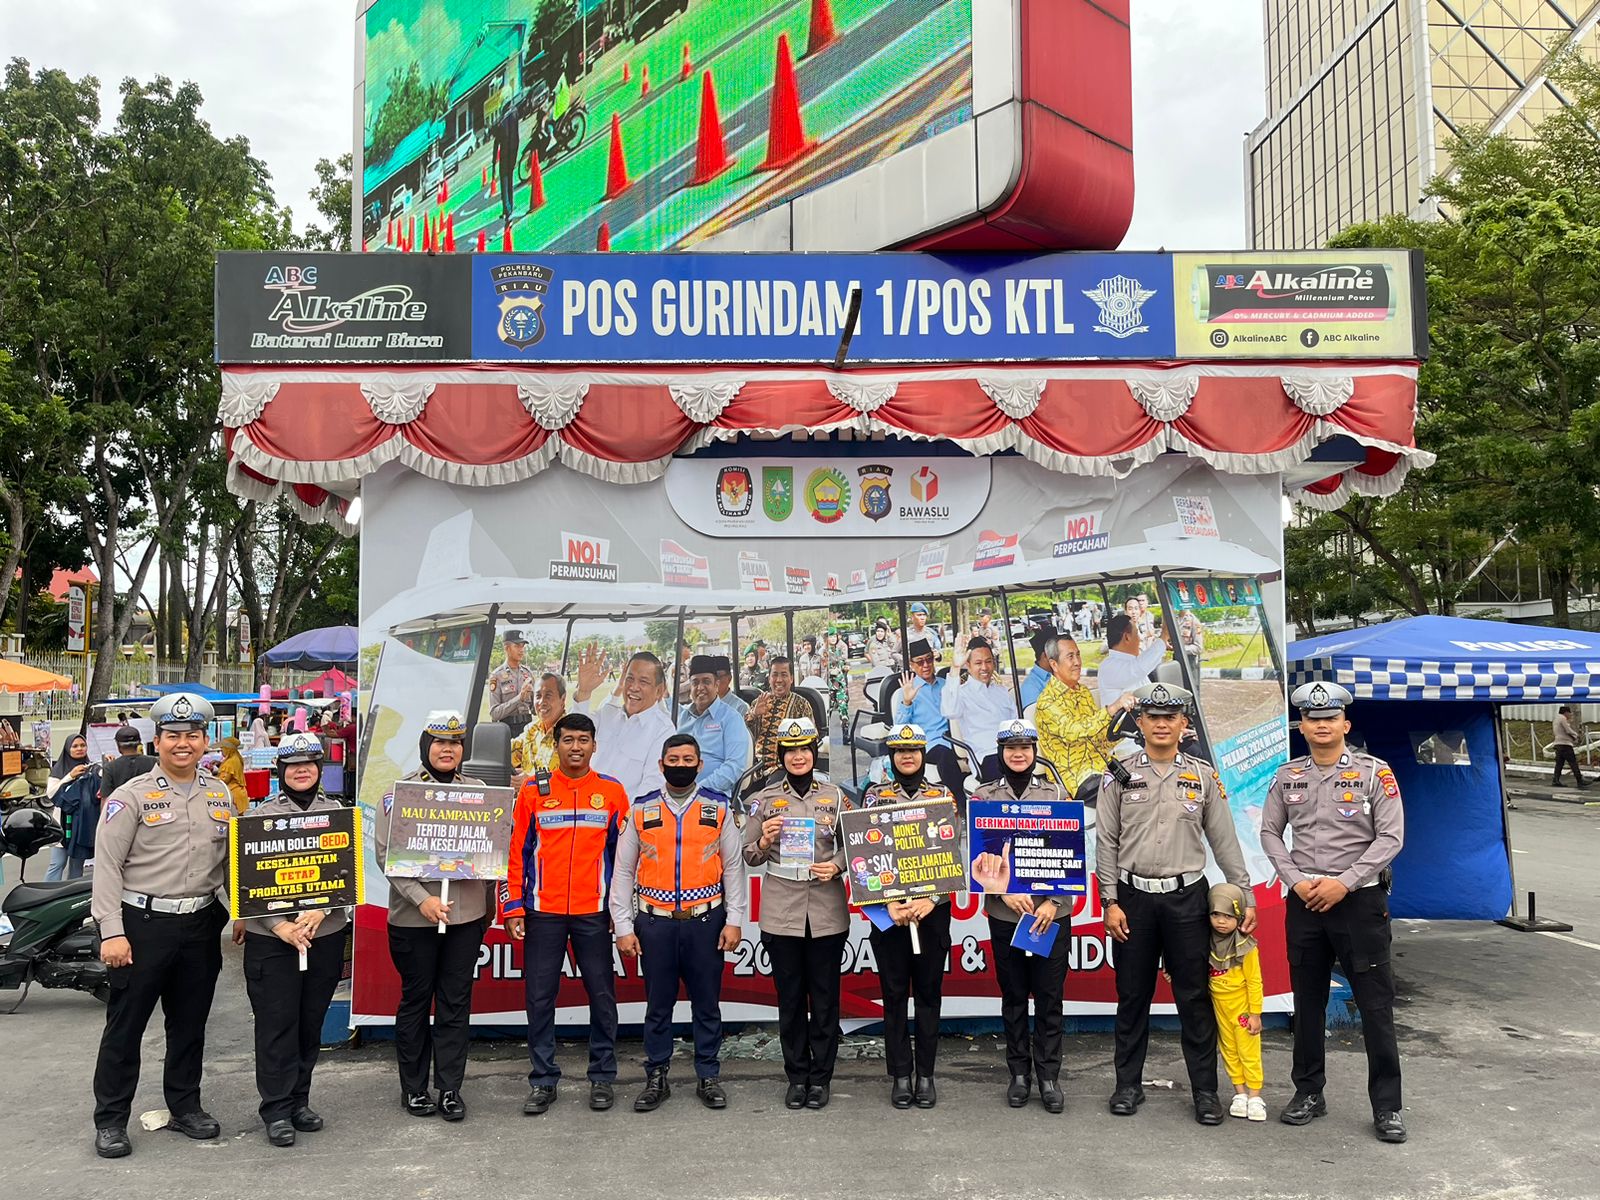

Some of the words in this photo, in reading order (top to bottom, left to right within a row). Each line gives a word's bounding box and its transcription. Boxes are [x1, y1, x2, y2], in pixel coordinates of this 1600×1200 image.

[265, 266, 317, 284] ABC
[1215, 275, 1245, 288] ABC
[1245, 270, 1373, 290] Alkaline
[500, 282, 542, 291] RIAU
[268, 291, 428, 321] Alkaline
[563, 279, 637, 336] POS
[652, 279, 861, 336] GURINDAM
[876, 279, 992, 335] 1/POS
[1005, 279, 1075, 334] KTL
[251, 332, 331, 348] Baterai
[334, 333, 383, 348] Luar
[386, 332, 443, 348] Biasa
[1233, 334, 1287, 343] AlkalineABC
[1323, 334, 1341, 342] ABC
[1344, 333, 1380, 342] Alkaline
[899, 506, 949, 517] BAWASLU
[1067, 515, 1095, 540] NO!
[568, 539, 601, 567] NO!
[1053, 536, 1109, 556] PERPECAHAN
[551, 564, 616, 580] PERMUSUHAN
[1334, 781, 1363, 789] POLRI
[143, 801, 171, 811] BOBY
[207, 800, 230, 809] POLRI
[401, 807, 427, 819] MAU
[429, 808, 491, 823] KAMPANYE
[416, 823, 447, 838] TERTIB
[448, 825, 458, 838] DI
[459, 826, 489, 840] JALAN,
[892, 823, 920, 837] MONEY
[975, 817, 1016, 829] BERIKAN
[1017, 818, 1038, 830] HAK
[1038, 819, 1080, 832] PILIHMU
[245, 839, 285, 855] PILIHAN
[287, 837, 320, 851] BOLEH
[321, 834, 348, 848] BEDA
[406, 837, 429, 851] JAGA
[430, 838, 493, 853] KESELAMATAN
[849, 832, 864, 846] SAY
[895, 835, 926, 851] POLITIK
[1014, 838, 1045, 848] JANGAN
[897, 852, 954, 871] KESELAMATAN
[1015, 848, 1074, 859] MENGGUNAKAN
[256, 854, 338, 871] KESELAMATAN
[873, 853, 894, 872] SAY
[1015, 858, 1062, 868] HANDPHONE
[1062, 859, 1082, 869] SAAT
[280, 869, 316, 881] TETAP
[899, 867, 935, 884] BERLALU
[935, 864, 963, 879] LINTAS
[1015, 868, 1067, 879] BERKENDARA
[249, 884, 303, 898] PRORITAS
[306, 879, 346, 893] UTAMA
